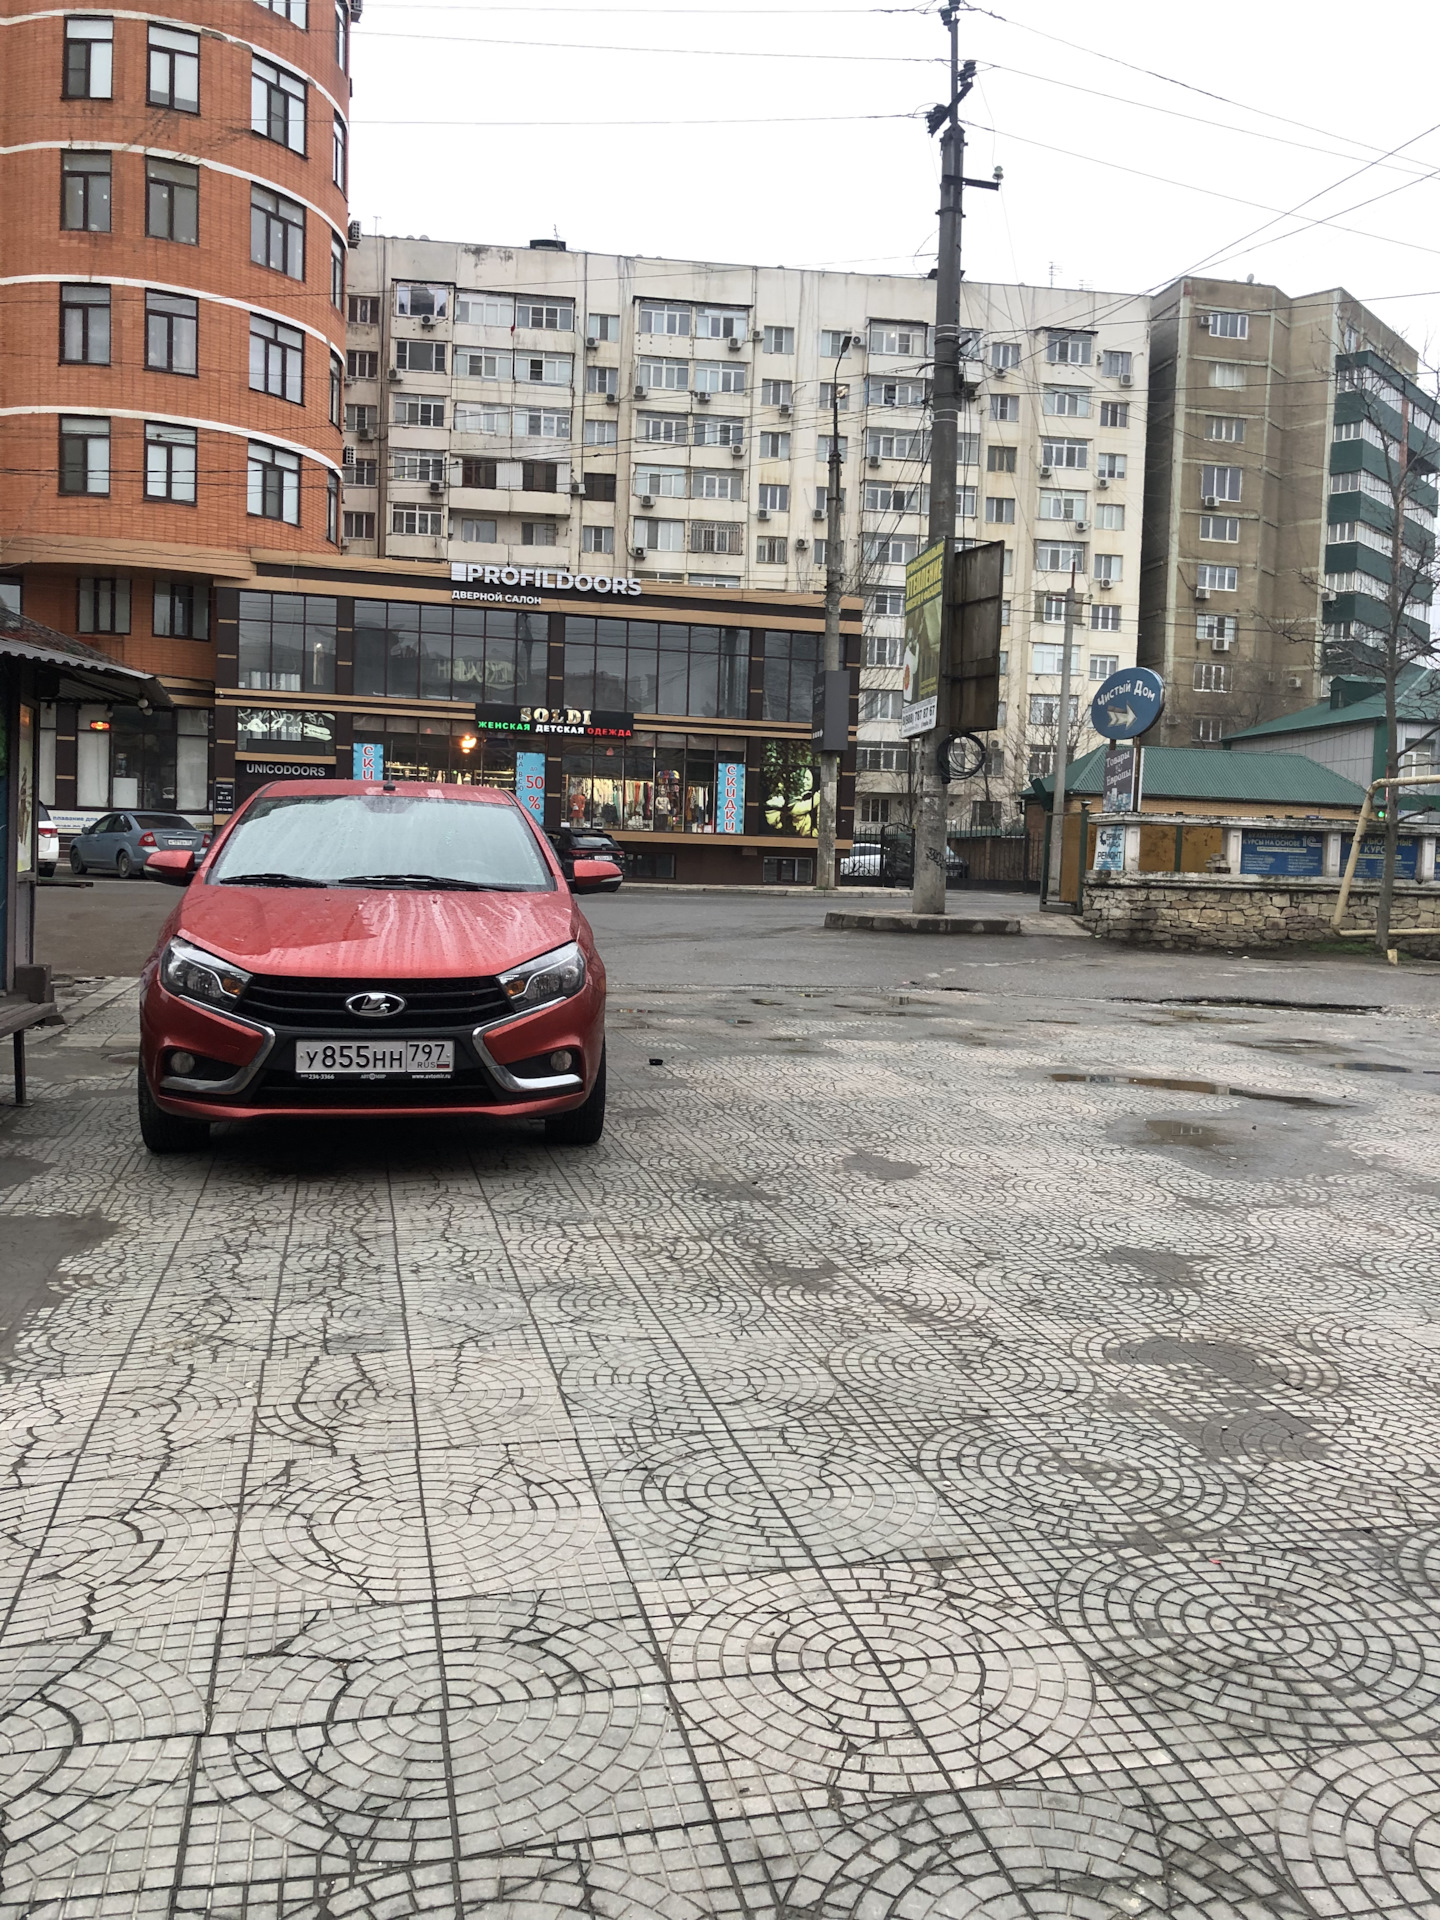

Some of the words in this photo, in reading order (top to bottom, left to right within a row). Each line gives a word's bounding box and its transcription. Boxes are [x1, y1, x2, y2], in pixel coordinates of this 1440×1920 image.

[467, 563, 642, 596] PROFILDOORS
[451, 590, 503, 602] ДВЕРНОЙ
[505, 594, 542, 605] САЛОН
[520, 707, 592, 726] SOLDI
[478, 720, 531, 732] ЖЕНСКАЯ
[535, 724, 585, 735] ДЕТСКАЯ
[587, 727, 632, 737] ОДЕЖДА
[1106, 750, 1130, 768] Товары
[246, 763, 326, 777] UNICODOORS
[1106, 768, 1132, 786] Европы
[526, 775, 544, 789] 50
[528, 796, 540, 810] %
[1097, 851, 1122, 860] РЕМОНТ
[409, 1044, 445, 1061] 797
